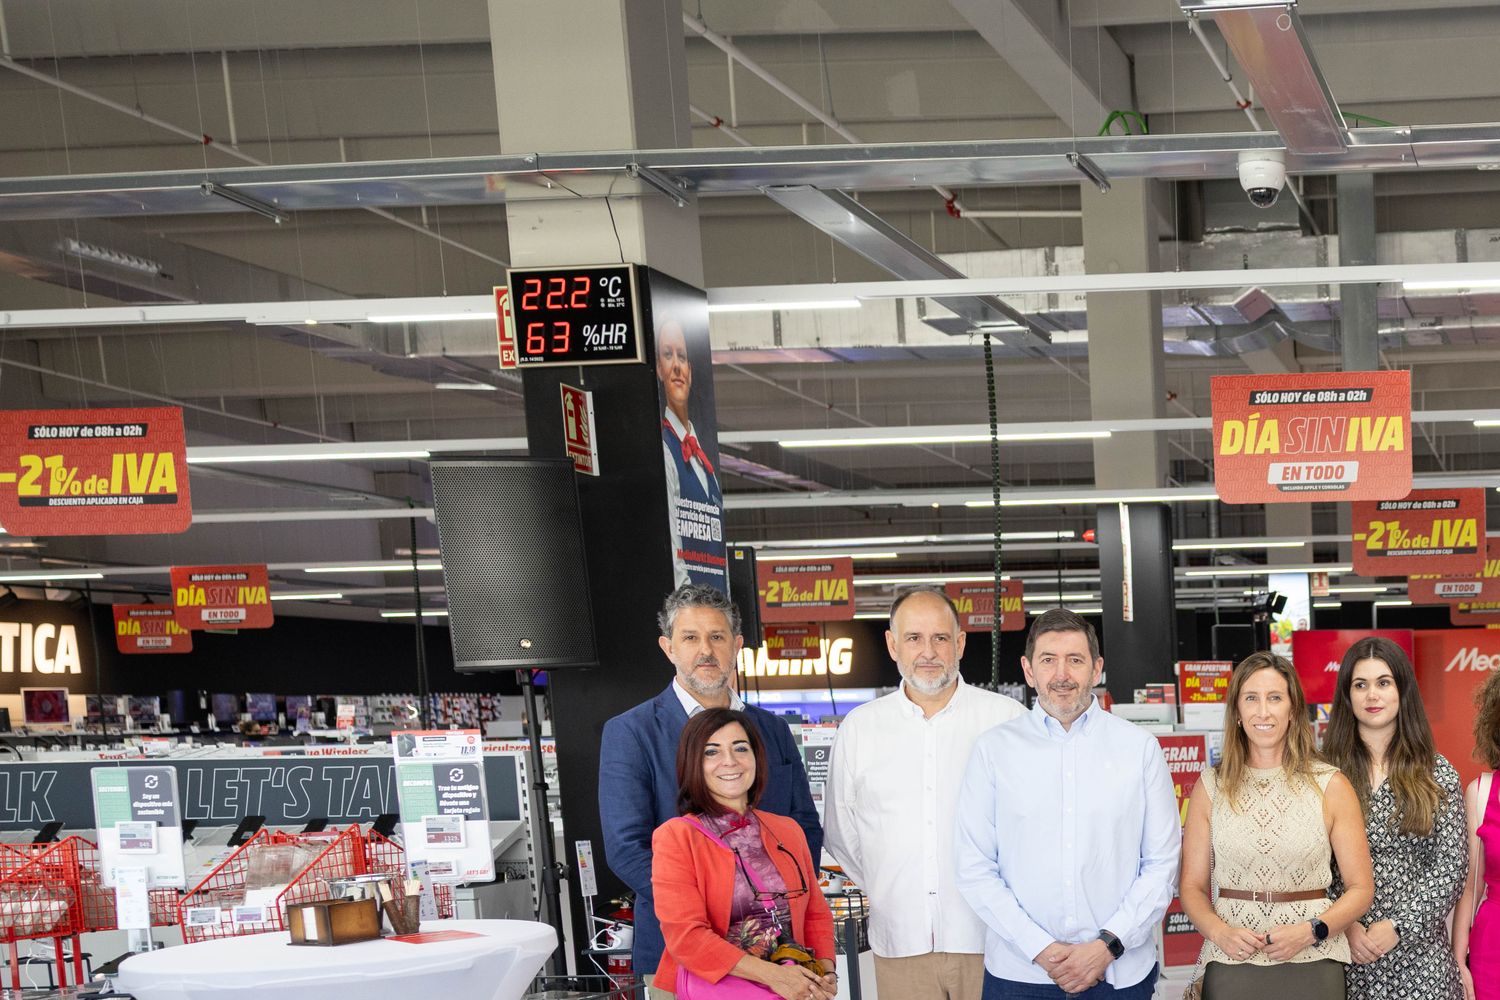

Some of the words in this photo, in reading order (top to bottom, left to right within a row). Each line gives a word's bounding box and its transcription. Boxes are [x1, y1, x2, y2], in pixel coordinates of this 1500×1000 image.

[522, 276, 591, 310] 22.2
[599, 276, 622, 298] °C
[526, 322, 570, 354] 63
[582, 323, 627, 346] %HR
[1255, 391, 1280, 404] SÓLO
[1280, 392, 1302, 403] HOY
[1302, 391, 1316, 403] de
[1317, 391, 1337, 402] 08h
[1338, 393, 1345, 402] a
[1347, 390, 1367, 402] 02h
[34, 425, 58, 438] SÓLO
[59, 426, 80, 438] HOY
[80, 426, 93, 437] de
[95, 425, 114, 437] 08h
[115, 427, 122, 437] a
[123, 425, 142, 436] 02h
[1220, 412, 1280, 455] DÍA
[1284, 416, 1347, 455] SIN
[1346, 416, 1404, 452] IVA
[0, 454, 82, 496] -21%
[84, 474, 109, 496] de
[111, 452, 177, 494] IVA
[1281, 466, 1303, 481] EN
[1305, 465, 1345, 481] TODO
[49, 496, 86, 506] DESCUENTO
[86, 496, 118, 506] APLICADO
[118, 496, 128, 505] EN
[128, 496, 144, 505] CAJA
[1380, 501, 1396, 510] SÓLO
[1397, 501, 1412, 510] HOY
[1412, 501, 1422, 509] de
[1422, 500, 1436, 509] 08h
[1442, 500, 1456, 509] 02h
[676, 519, 712, 542] EMPRESA
[1354, 520, 1410, 549] -21%
[1412, 534, 1430, 548] de
[1431, 518, 1477, 548] IVA
[177, 584, 207, 607] DÍA
[207, 586, 238, 605] SIN
[238, 586, 267, 605] IVA
[759, 580, 799, 603] -21%
[800, 590, 813, 601] de
[813, 578, 849, 601] IVA
[1454, 584, 1475, 592] TODO
[208, 610, 218, 619] EN
[220, 609, 239, 619] TODO
[118, 618, 141, 635] DÍA
[1163, 746, 1199, 761] GRAN
[1169, 761, 1206, 773] ERTURA
[0, 770, 57, 823] LK
[322, 766, 400, 817] TA
